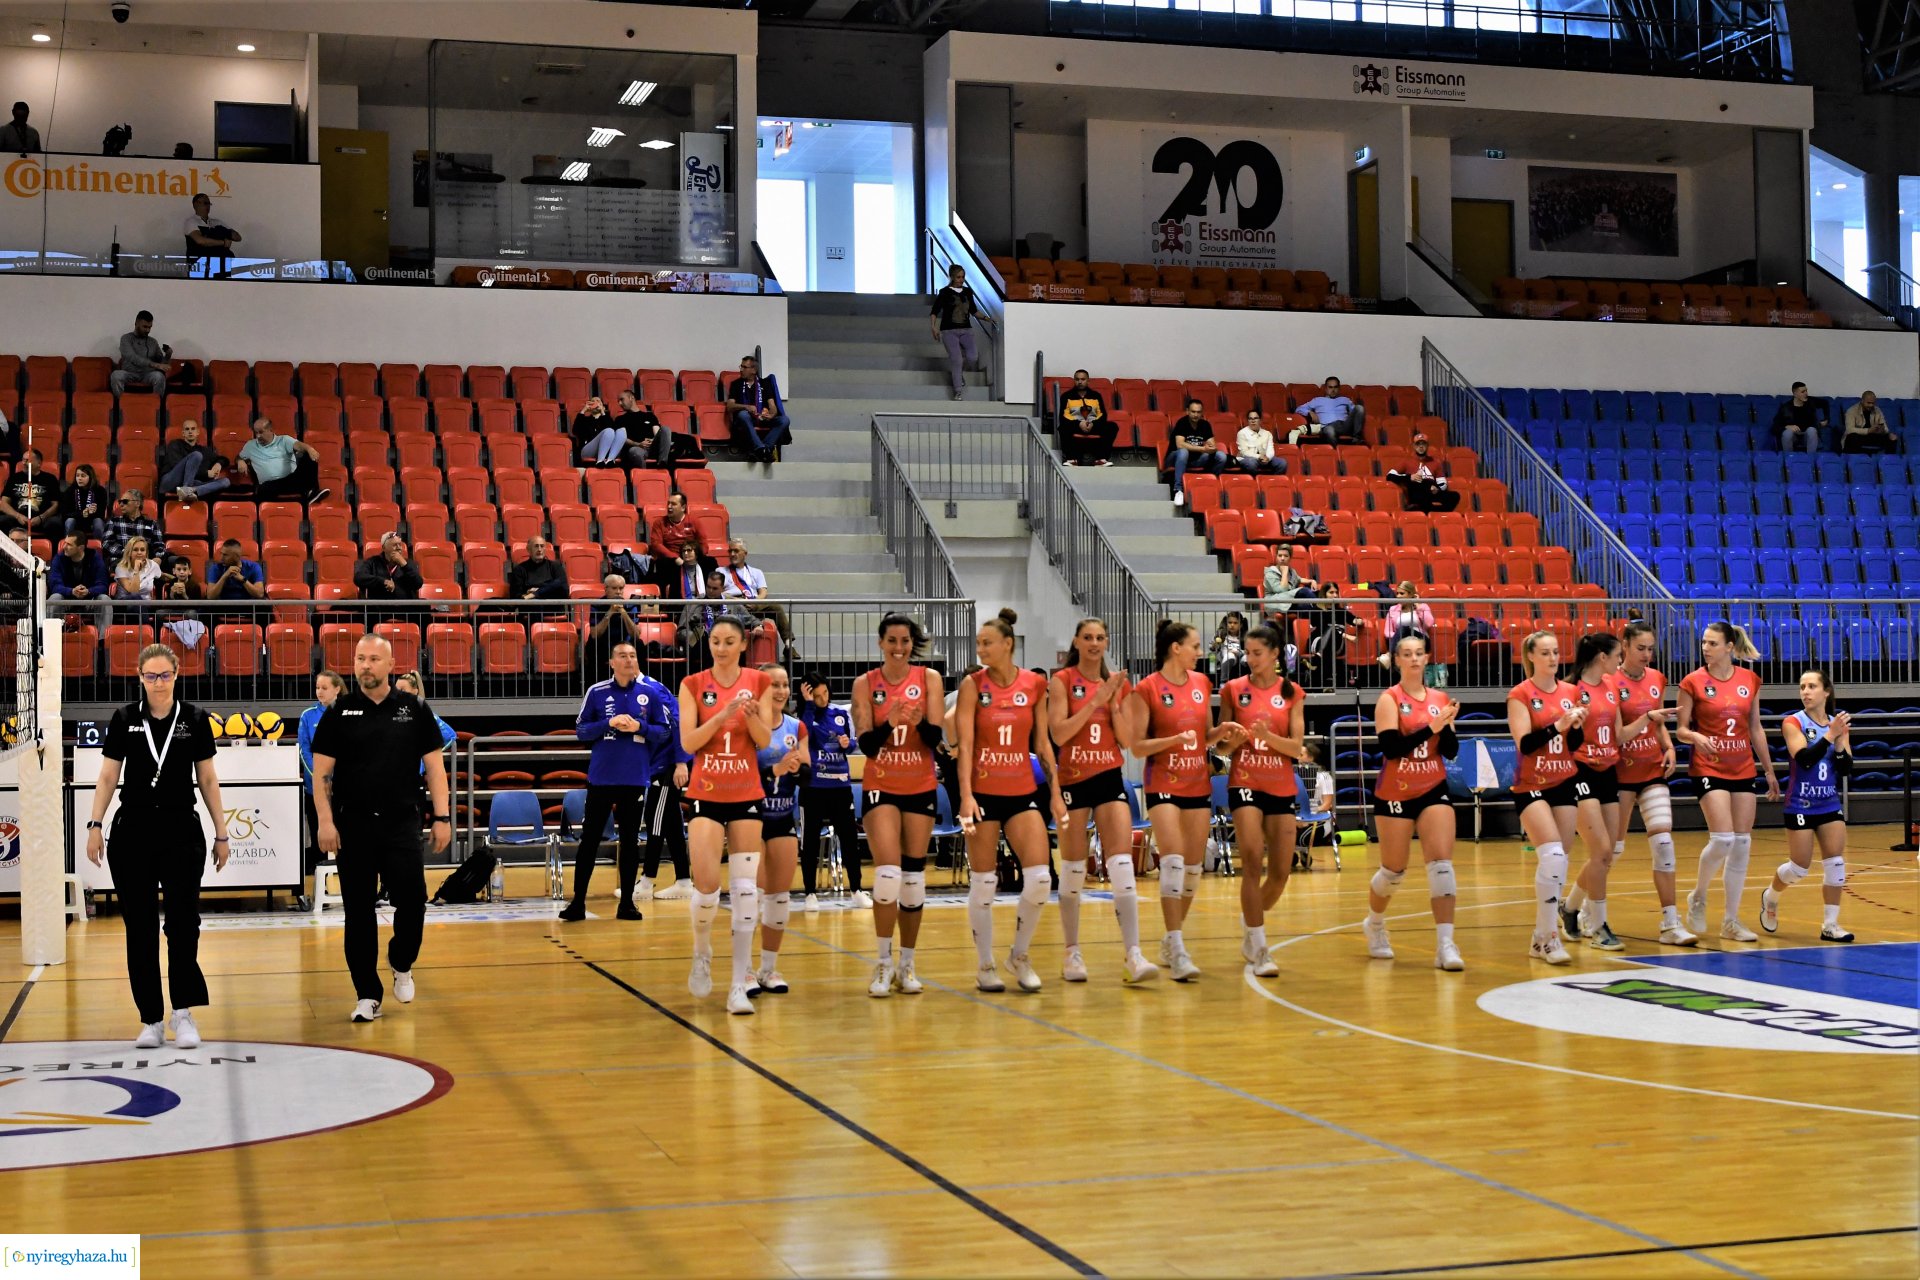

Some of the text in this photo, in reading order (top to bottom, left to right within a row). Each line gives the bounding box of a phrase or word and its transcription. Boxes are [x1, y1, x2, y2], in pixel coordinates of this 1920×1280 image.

[1395, 65, 1466, 86] Eissmann
[1396, 84, 1466, 97] Group Automotive
[4, 158, 199, 198] Continental
[1151, 136, 1284, 231] 20
[1198, 221, 1276, 243] Eissmann
[1199, 242, 1276, 255] Group Automotive
[1171, 257, 1189, 266] ÉVE
[250, 262, 316, 278] Contnental
[364, 266, 430, 280] Continental
[476, 269, 541, 284] Continental
[586, 272, 649, 287] Continental
[1049, 284, 1085, 295] Eissmann
[1248, 291, 1283, 302] Eissmann
[1616, 304, 1647, 314] Eissmann
[128, 725, 145, 733] Zeu
[1089, 723, 1101, 745] 9
[1726, 717, 1736, 737] 2
[892, 724, 908, 747] 17
[998, 724, 1012, 746] 11
[1597, 725, 1610, 745] 10
[1709, 735, 1747, 750] FATUM
[723, 731, 731, 755] 1
[1549, 733, 1564, 755] 18
[702, 753, 750, 770] FATUM
[876, 747, 923, 763] FATUM
[980, 747, 1024, 763] FATUM
[1168, 753, 1205, 769] FATUM
[1239, 748, 1283, 766] FATUM
[1817, 762, 1828, 781] 8
[1575, 781, 1591, 796] 10
[1701, 777, 1711, 790] 2
[762, 796, 795, 809] ATUM
[868, 789, 881, 804] 17
[1063, 791, 1073, 805] 9
[1238, 788, 1254, 802] 12
[693, 799, 700, 814] 1
[1387, 800, 1403, 814] 13
[1796, 813, 1806, 826] 8
[211, 847, 277, 858] PLABDA
